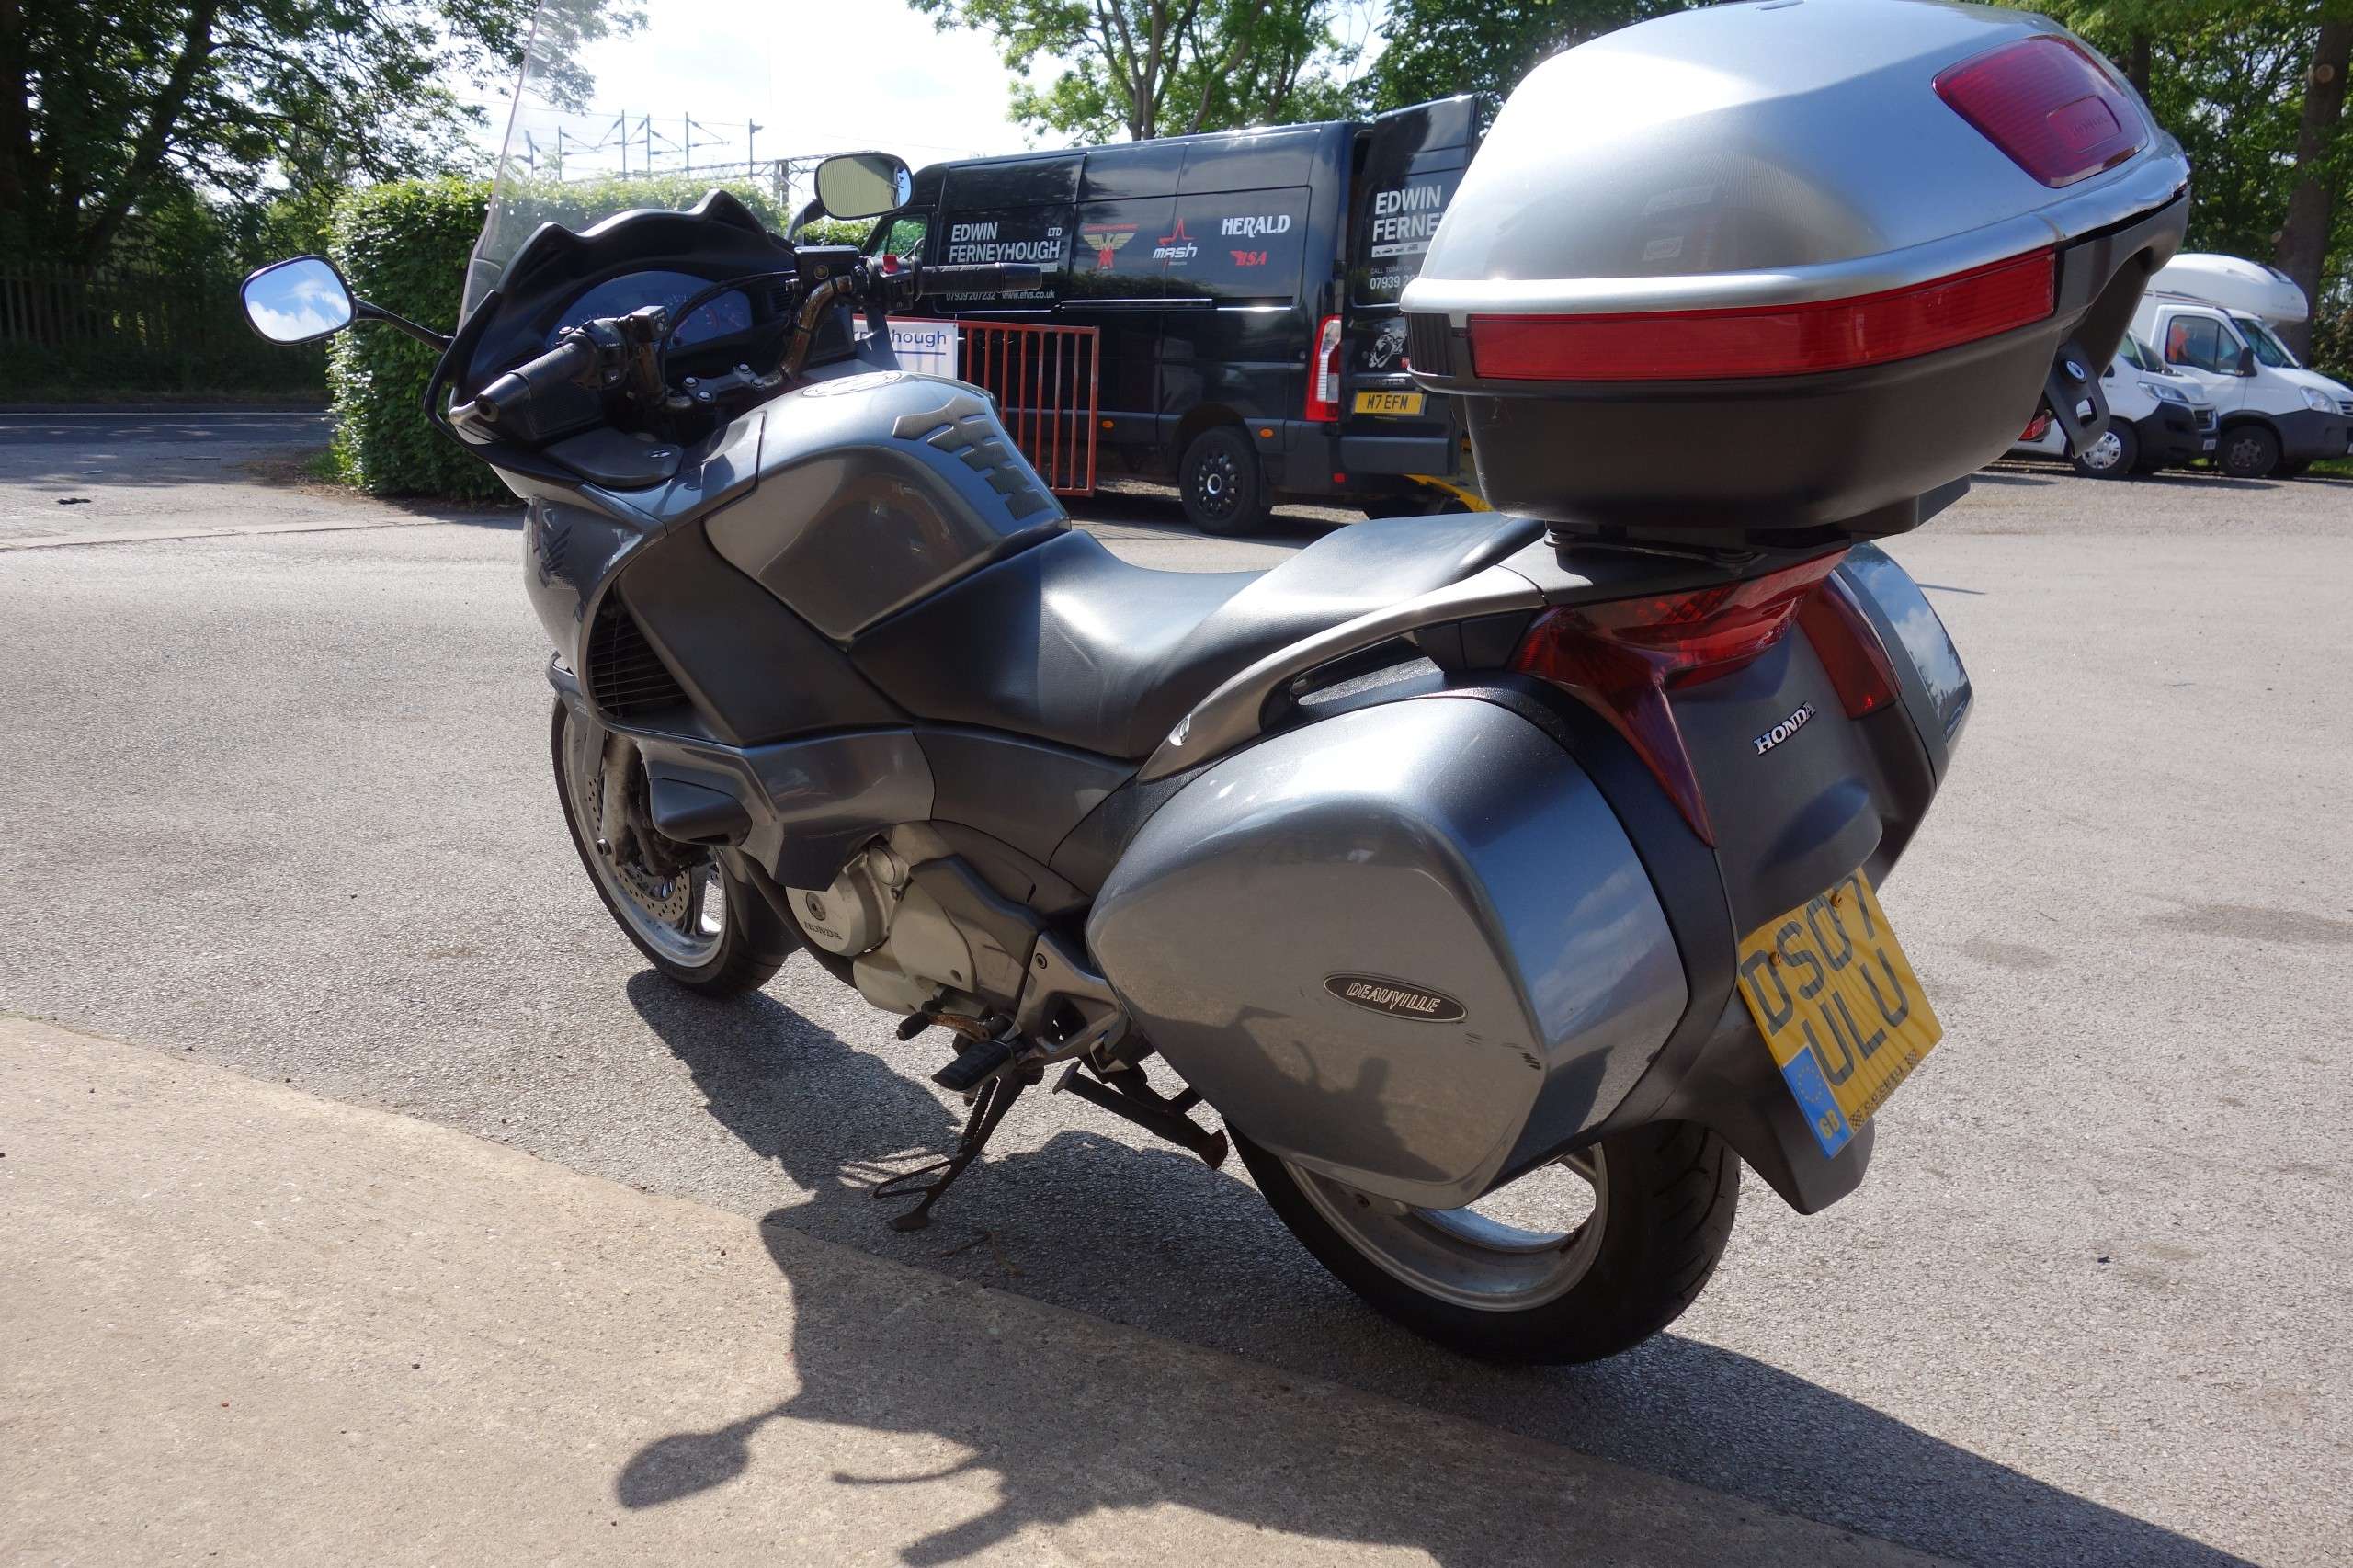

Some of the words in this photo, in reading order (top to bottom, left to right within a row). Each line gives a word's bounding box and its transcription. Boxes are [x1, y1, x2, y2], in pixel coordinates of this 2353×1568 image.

[1375, 185, 1442, 215] EDWIN
[950, 222, 999, 242] EDWIN
[1047, 227, 1062, 237] LTD
[1221, 214, 1290, 238] HERALD
[1372, 211, 1445, 242] FERNE
[949, 240, 1061, 263] FERNEYHOUGH
[1370, 275, 1401, 290] 07939
[1367, 394, 1382, 409] M7
[1384, 395, 1409, 410] EFM
[1753, 701, 1816, 755] HONDA
[804, 921, 843, 940] HONDA
[1740, 872, 1875, 1037] DS07
[1346, 982, 1440, 1013] DEAUVILLE
[1801, 947, 1909, 1086] ULU
[1819, 1109, 1840, 1139] GB
